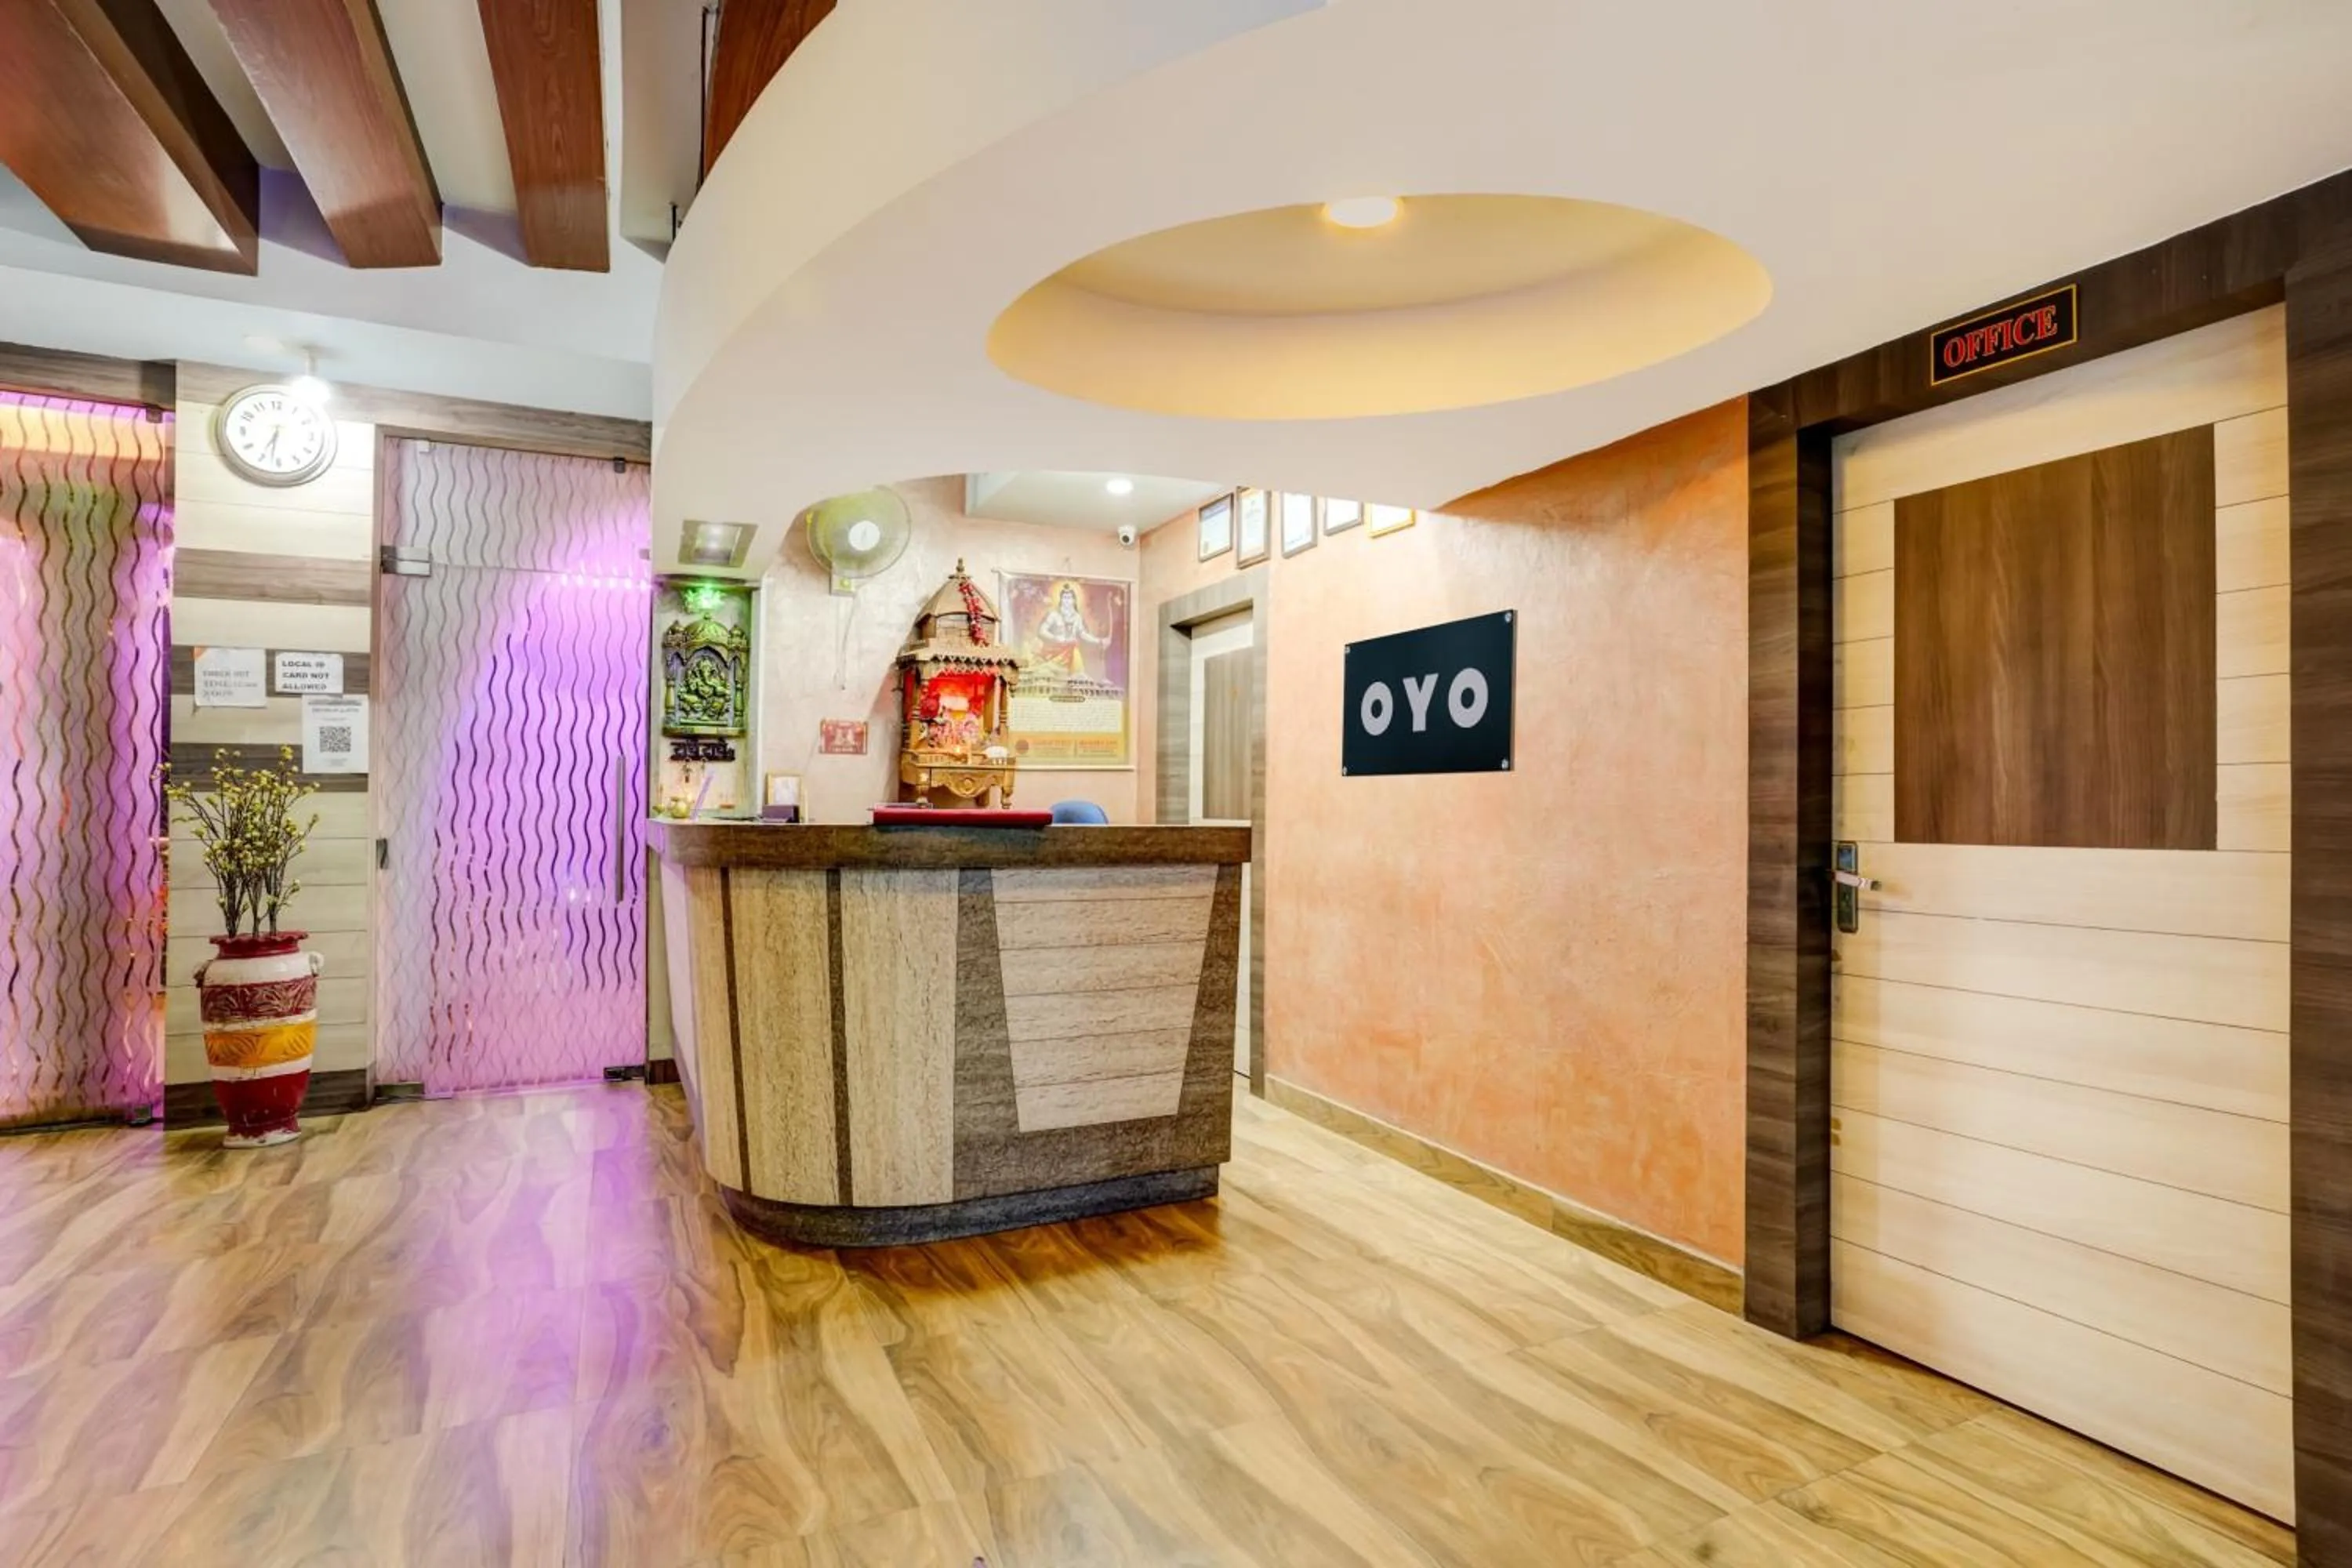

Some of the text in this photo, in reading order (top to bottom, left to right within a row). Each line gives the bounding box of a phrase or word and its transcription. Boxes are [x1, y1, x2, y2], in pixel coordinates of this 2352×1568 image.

[1944, 304, 2059, 368] OFFICE
[270, 401, 282, 411] 12
[1360, 667, 1489, 736] OYO
